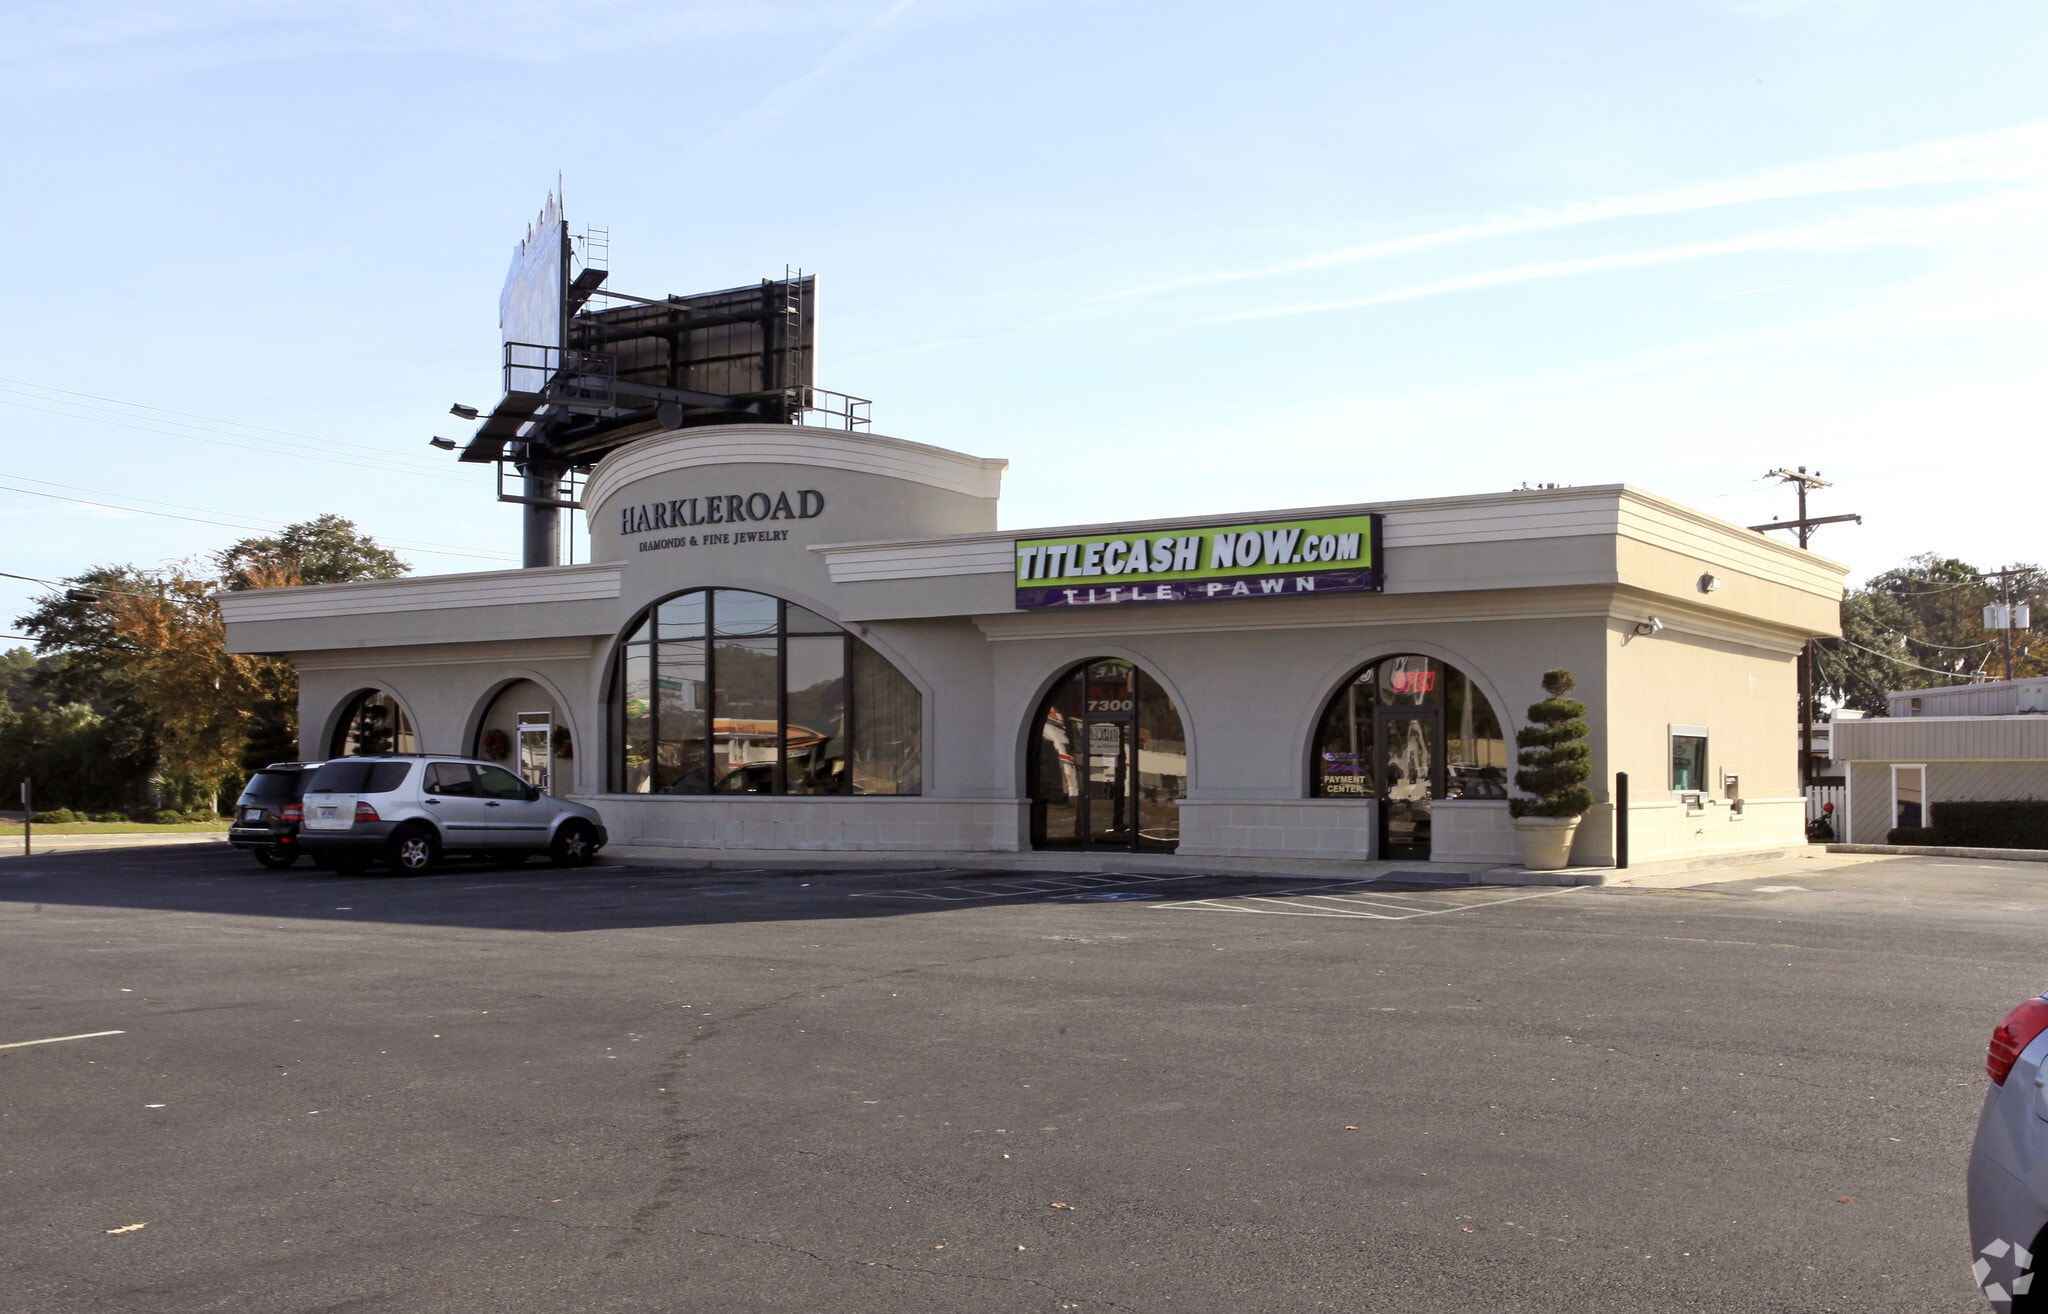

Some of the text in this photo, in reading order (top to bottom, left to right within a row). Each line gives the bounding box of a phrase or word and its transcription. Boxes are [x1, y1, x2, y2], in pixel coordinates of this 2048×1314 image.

[620, 489, 825, 535] HARKLEROAD
[639, 529, 789, 552] DIAMONDS & FINE JEWELRY
[1016, 535, 1202, 580] TITLECASH
[1062, 576, 1315, 604] TITLE PAWN
[1392, 670, 1436, 693] OPEN
[1087, 700, 1133, 711] 7300
[1324, 775, 1365, 783] PAYMENT
[1327, 785, 1362, 793] CENTER
